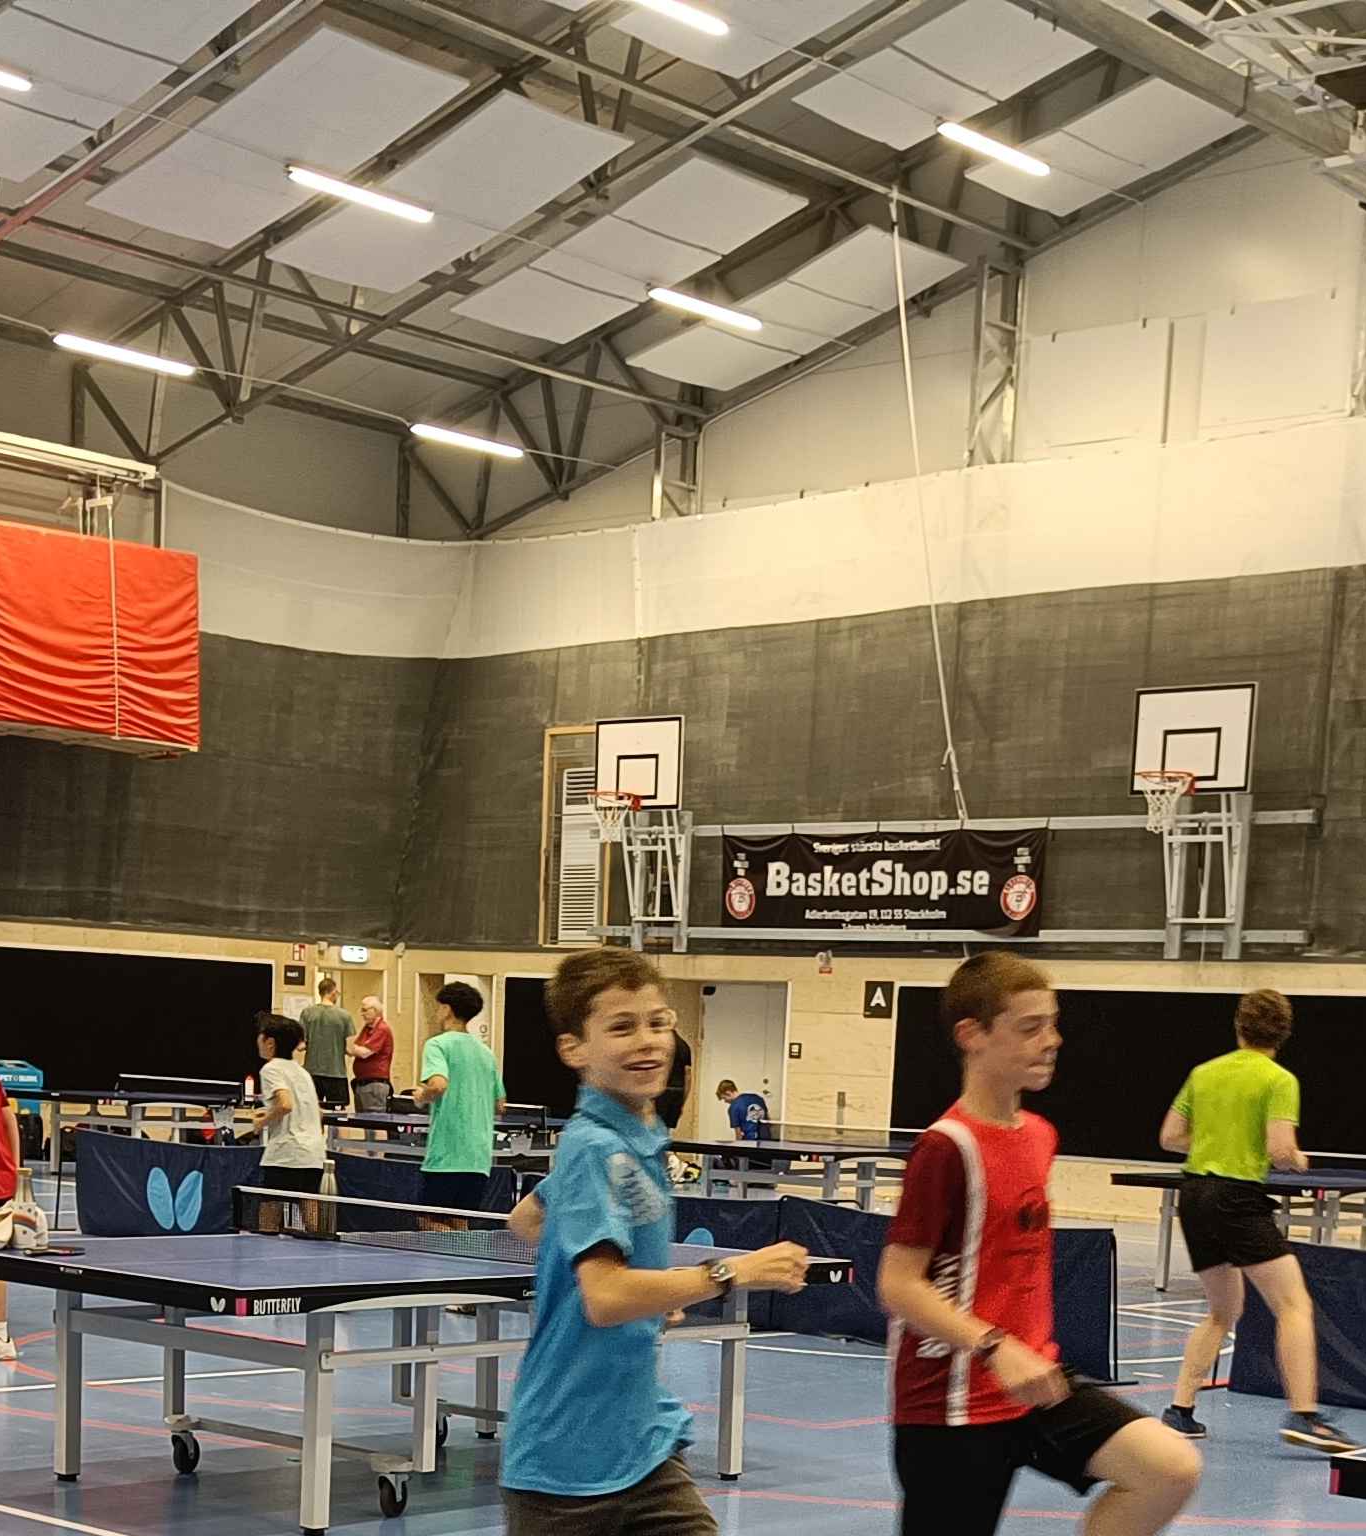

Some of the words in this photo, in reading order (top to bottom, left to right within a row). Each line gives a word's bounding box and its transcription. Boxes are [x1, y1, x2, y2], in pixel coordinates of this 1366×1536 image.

[765, 859, 990, 900] BasketShop.se
[870, 986, 887, 1008] A
[253, 1296, 302, 1315] BUTTERFLY
